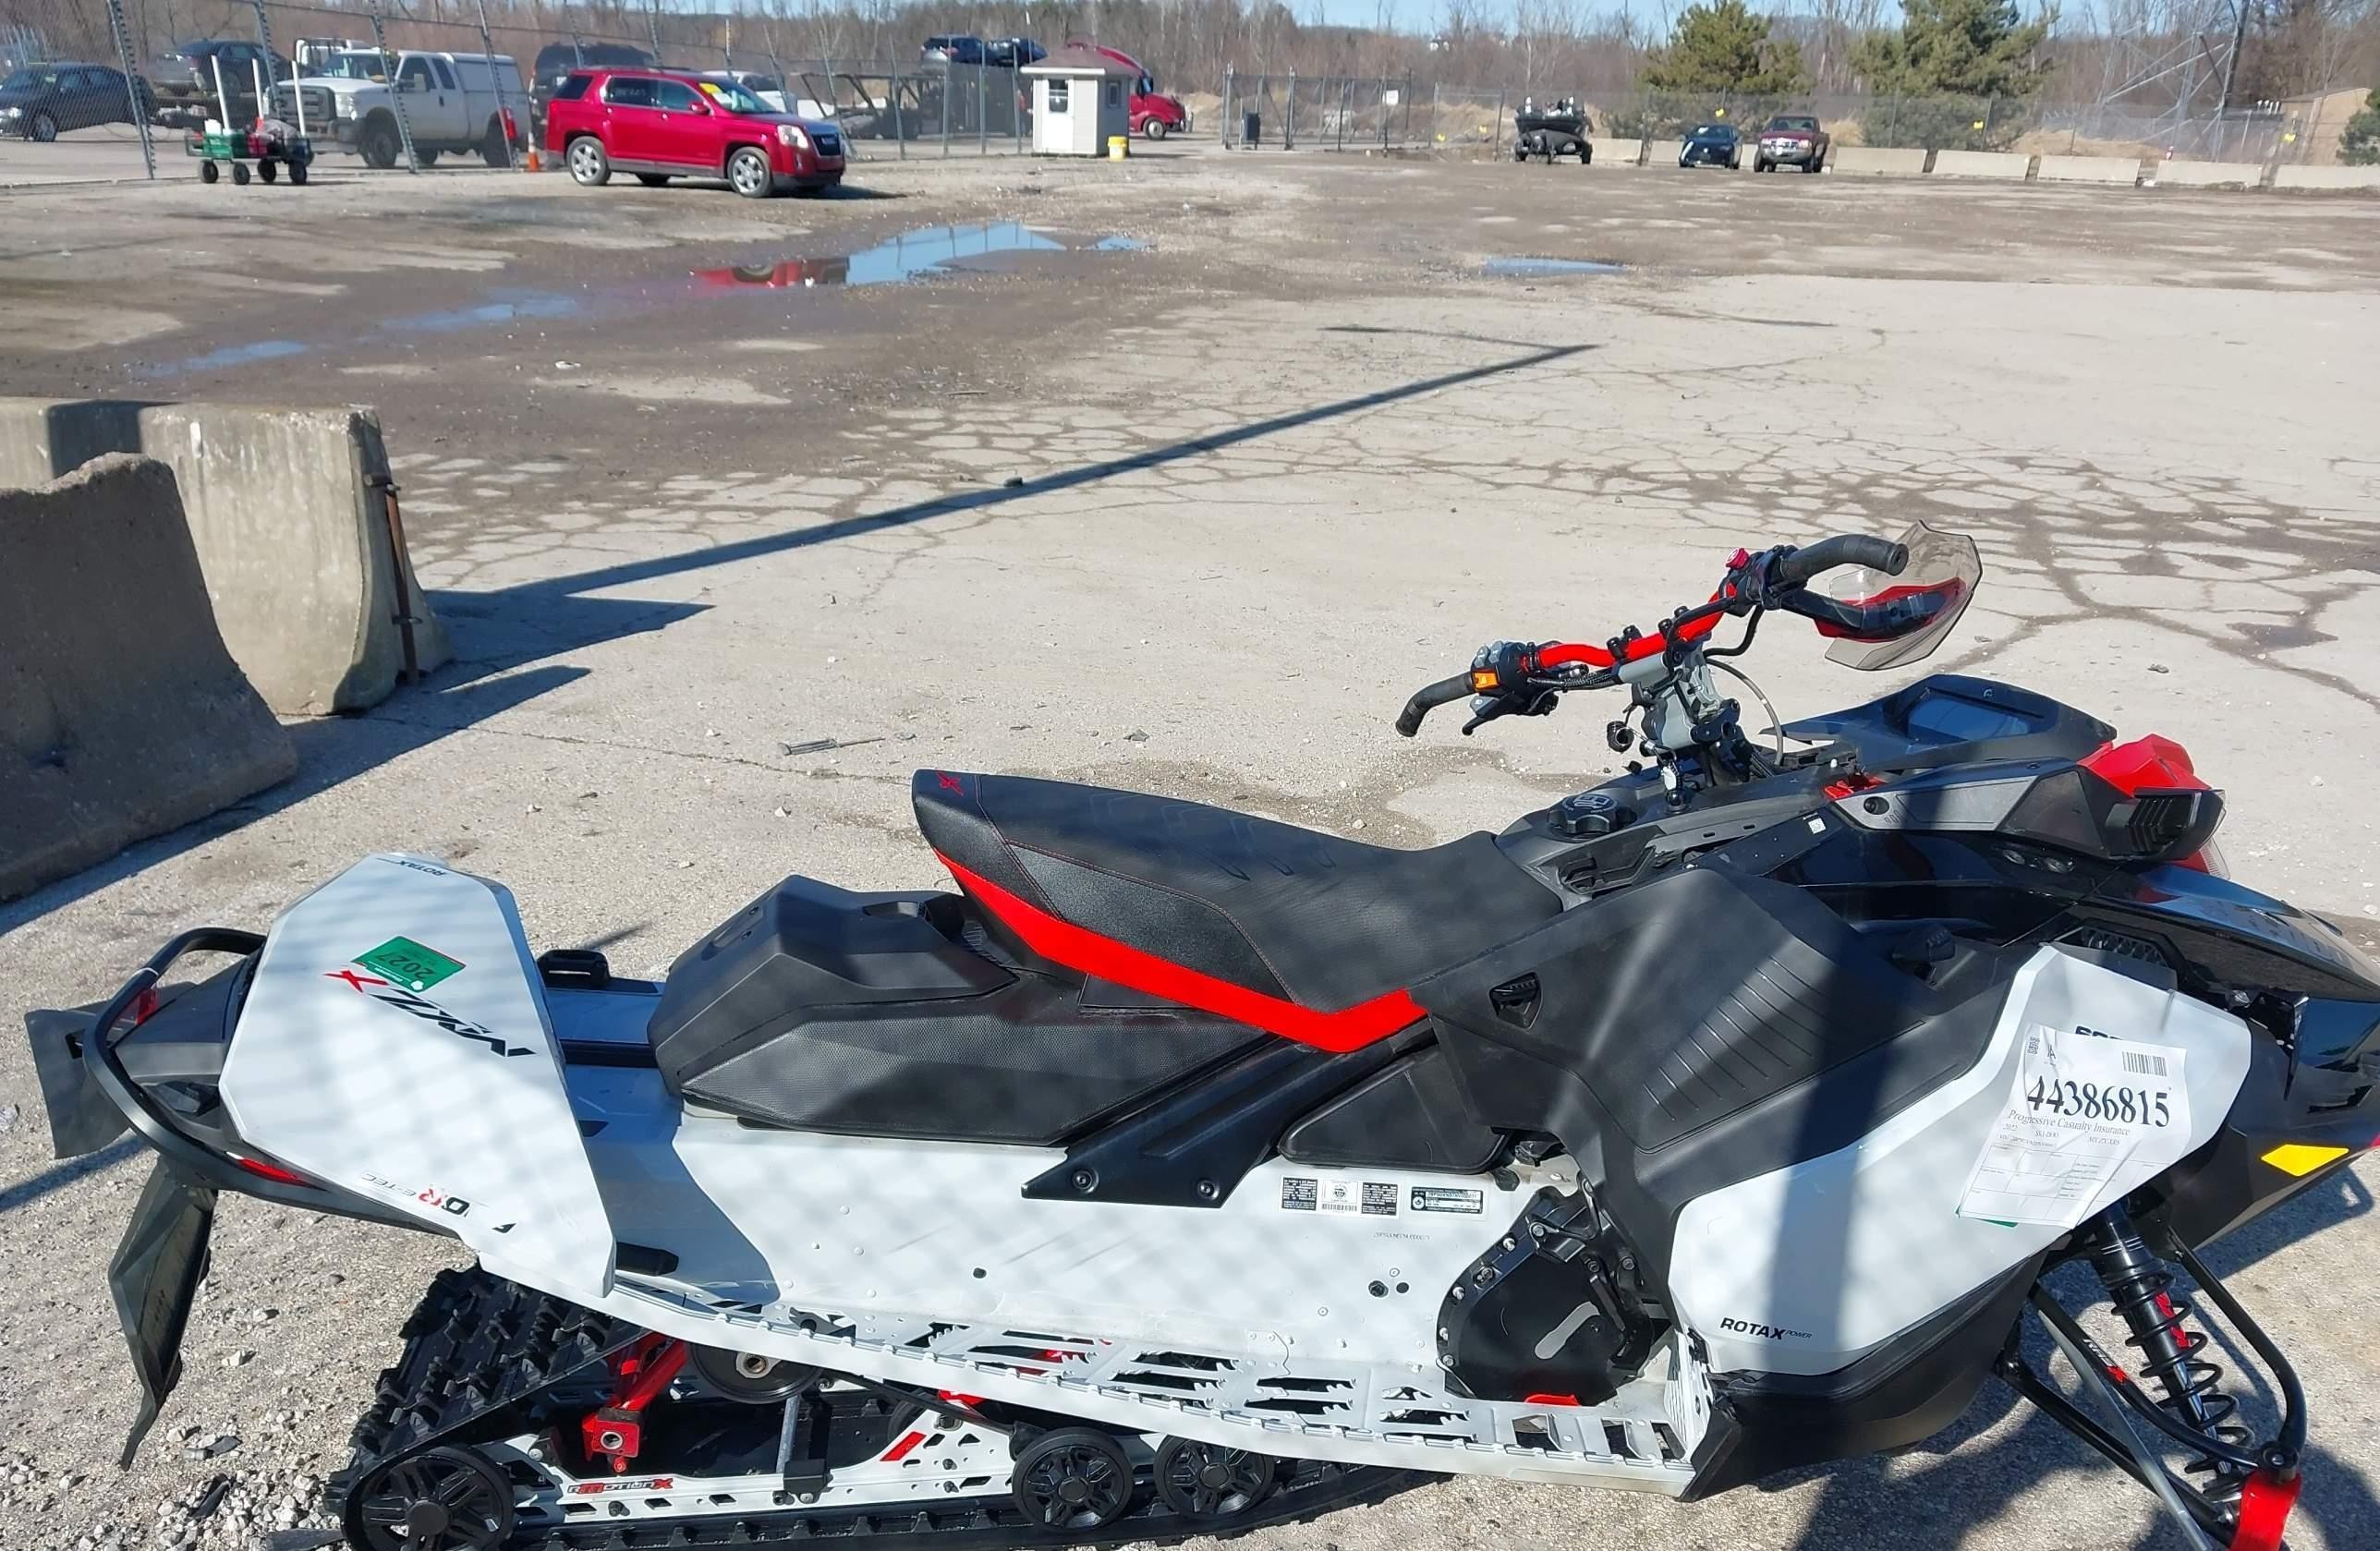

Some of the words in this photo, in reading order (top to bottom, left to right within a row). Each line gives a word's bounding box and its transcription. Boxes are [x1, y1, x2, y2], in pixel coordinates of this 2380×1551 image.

[399, 860, 448, 877] ROTAX
[376, 951, 436, 980] 2027
[2027, 1075, 2170, 1127] 44386815
[2009, 1109, 2055, 1125] Progressive
[2057, 1118, 2093, 1133] Casualty
[2094, 1121, 2131, 1136] Insurance
[1720, 1317, 1786, 1340] ROTAX
